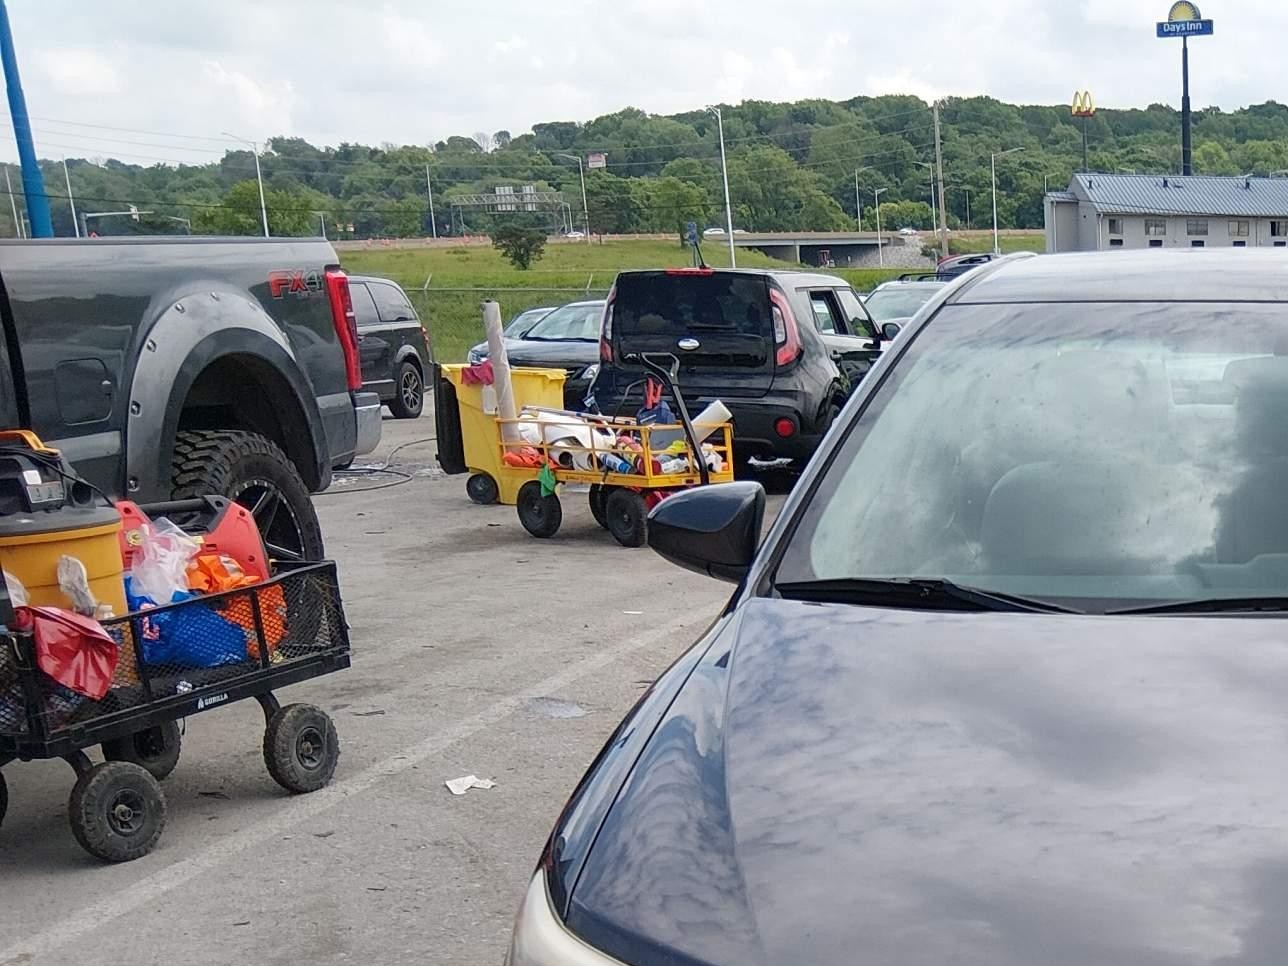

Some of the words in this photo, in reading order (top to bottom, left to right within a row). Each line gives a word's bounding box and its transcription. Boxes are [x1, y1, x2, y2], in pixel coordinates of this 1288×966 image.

[1163, 23, 1185, 33] Days
[1186, 22, 1202, 31] Inn
[268, 269, 323, 299] FX4
[204, 693, 229, 706] GORILLA
